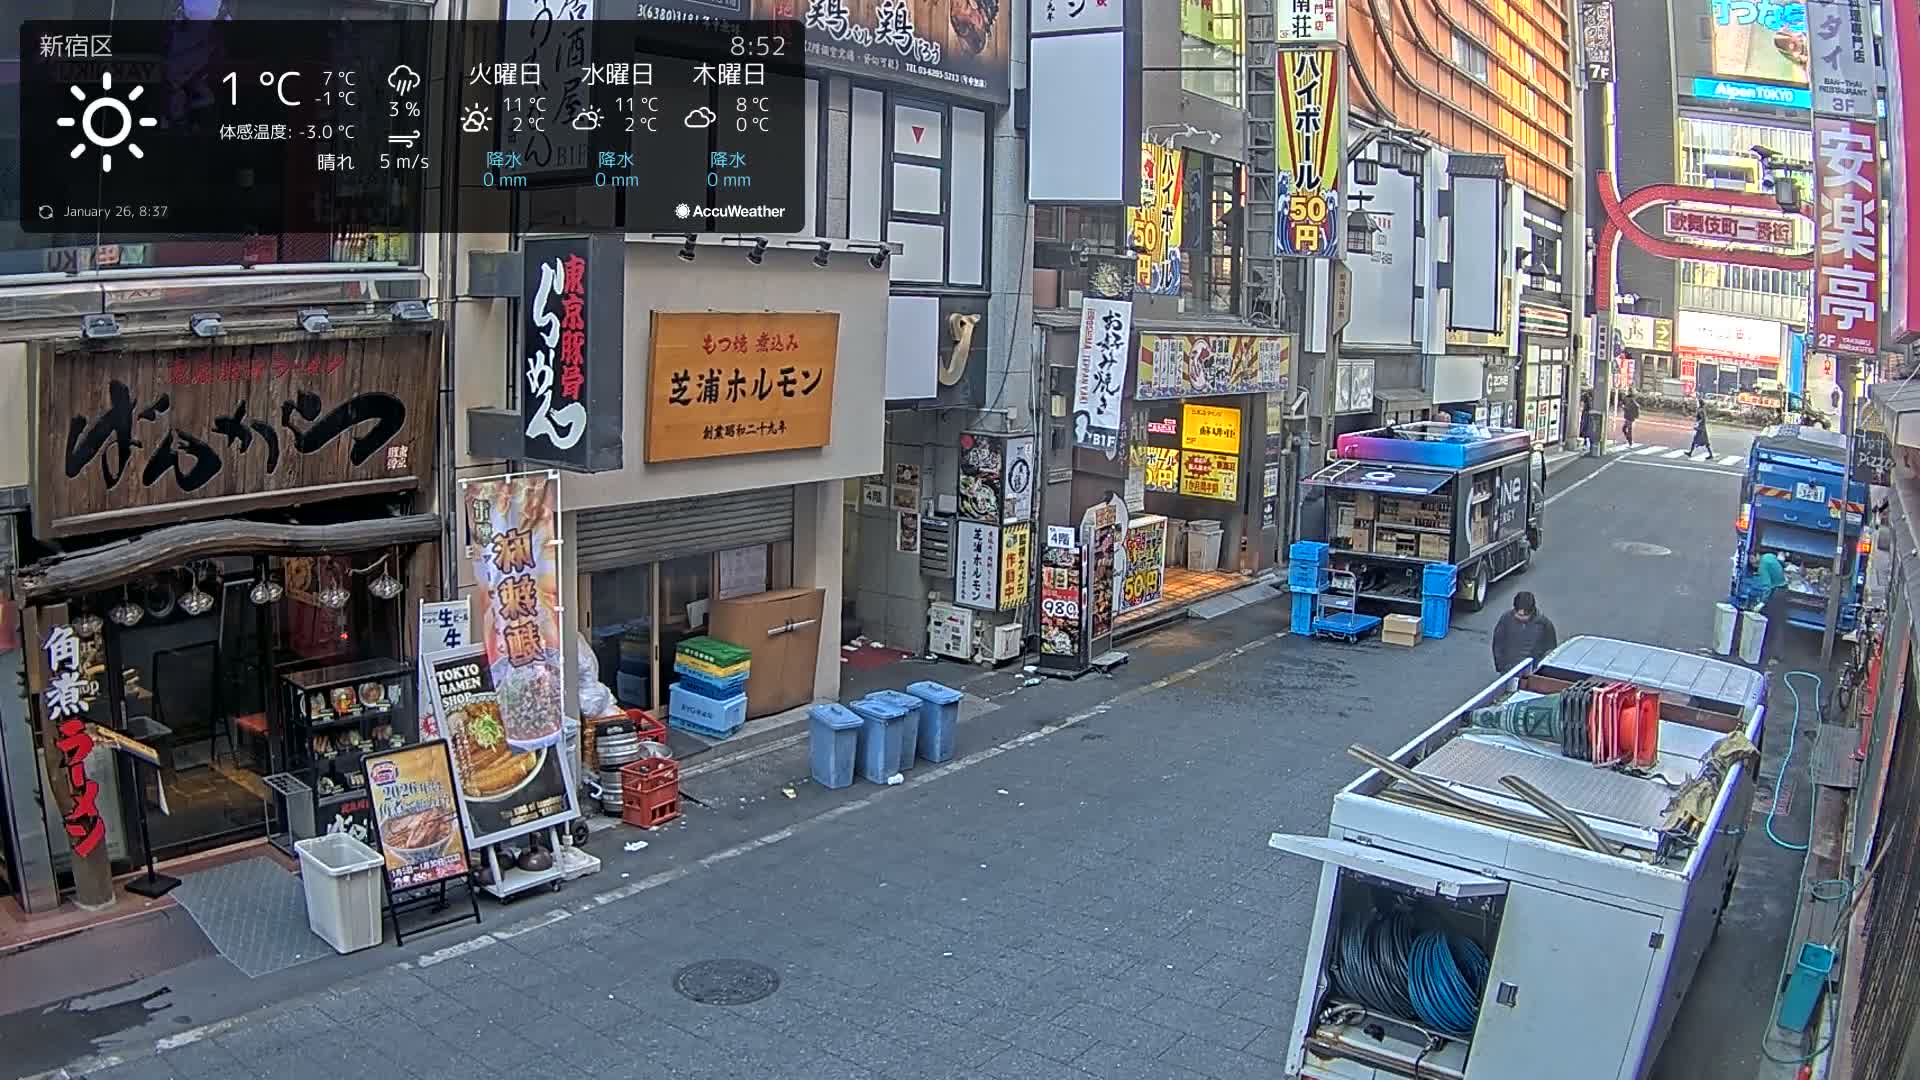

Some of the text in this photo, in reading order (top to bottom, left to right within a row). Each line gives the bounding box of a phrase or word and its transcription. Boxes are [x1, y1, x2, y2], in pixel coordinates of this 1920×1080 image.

[1589, 64, 1610, 79] 7F
[1757, 88, 1794, 102] TOKYO
[1832, 98, 1855, 112] 3F
[1294, 54, 1322, 190] ハイボール
[1289, 197, 1327, 221] 50
[1134, 220, 1158, 251] 50
[1294, 225, 1319, 251] 円
[1669, 211, 1790, 241] 歌舞伎町一番街
[1820, 127, 1875, 331] 安楽亭
[755, 333, 800, 353] 煮込み
[1818, 333, 1836, 347] 2F
[1091, 310, 1125, 416] お好み焼き
[668, 366, 823, 406] 芝浦ホルモン
[438, 608, 453, 628] 生
[44, 625, 89, 721] 角煮
[434, 663, 480, 683] TOKYO
[439, 676, 482, 696] RAMEN
[441, 691, 472, 708] SHOP
[56, 719, 106, 859] ラーメン
